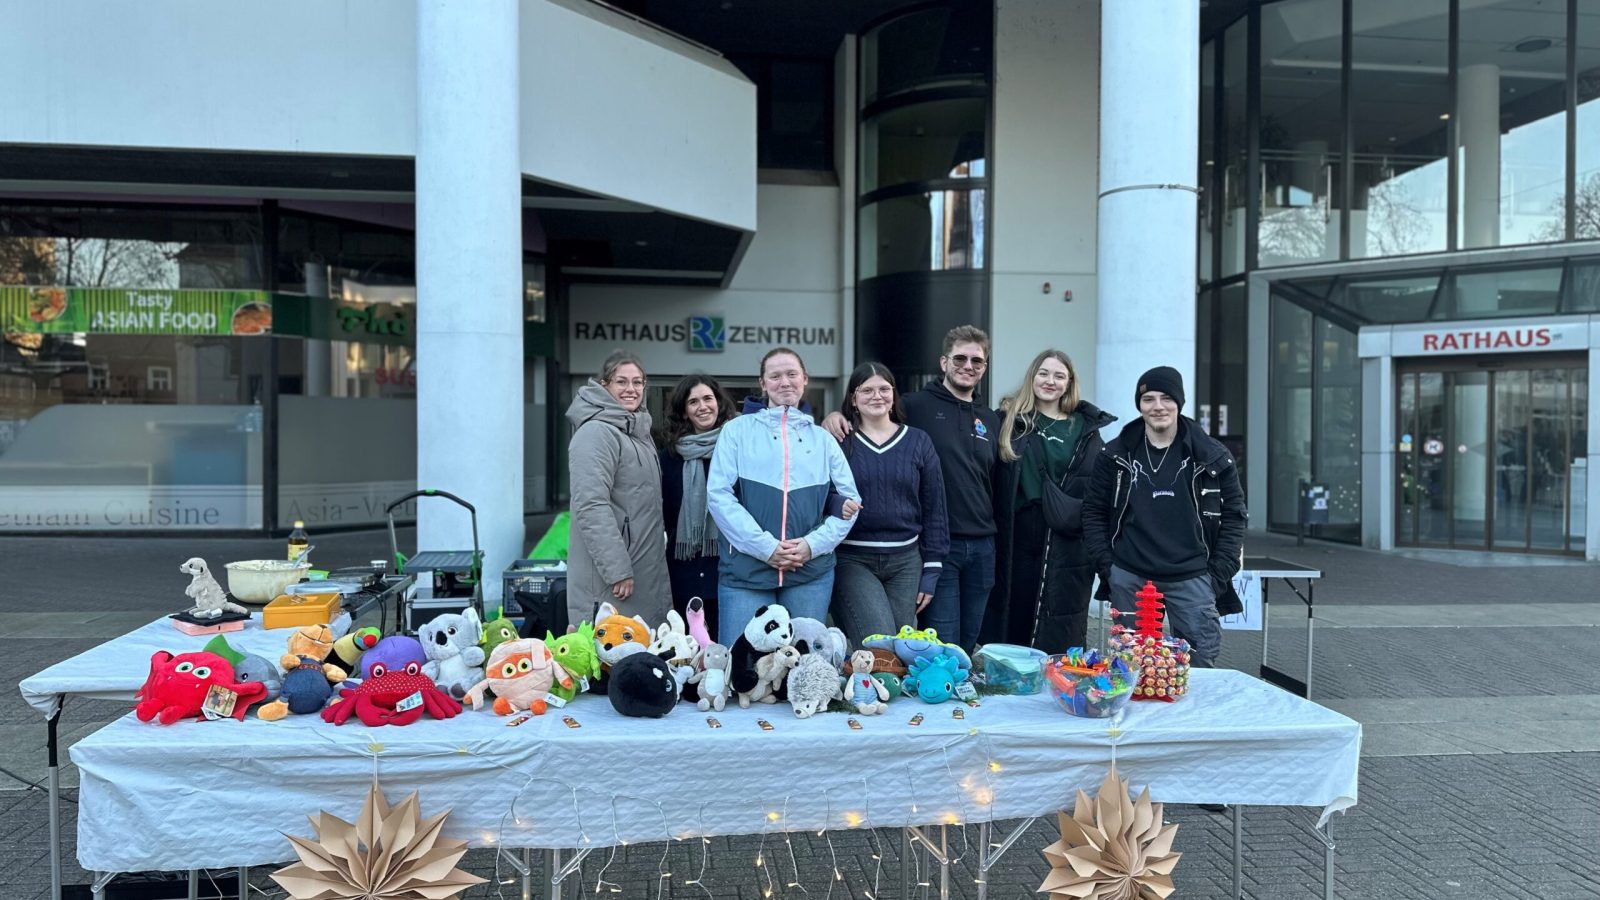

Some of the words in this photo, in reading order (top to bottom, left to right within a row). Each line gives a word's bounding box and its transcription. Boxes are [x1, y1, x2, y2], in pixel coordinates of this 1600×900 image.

[126, 291, 173, 311] Tasty
[91, 310, 154, 329] ASIAN
[159, 312, 217, 330] FOOD
[575, 322, 686, 343] RATHAUS
[728, 325, 836, 345] ZENTRUM
[1423, 328, 1552, 351] RATHAUS
[104, 500, 220, 527] Cuisine
